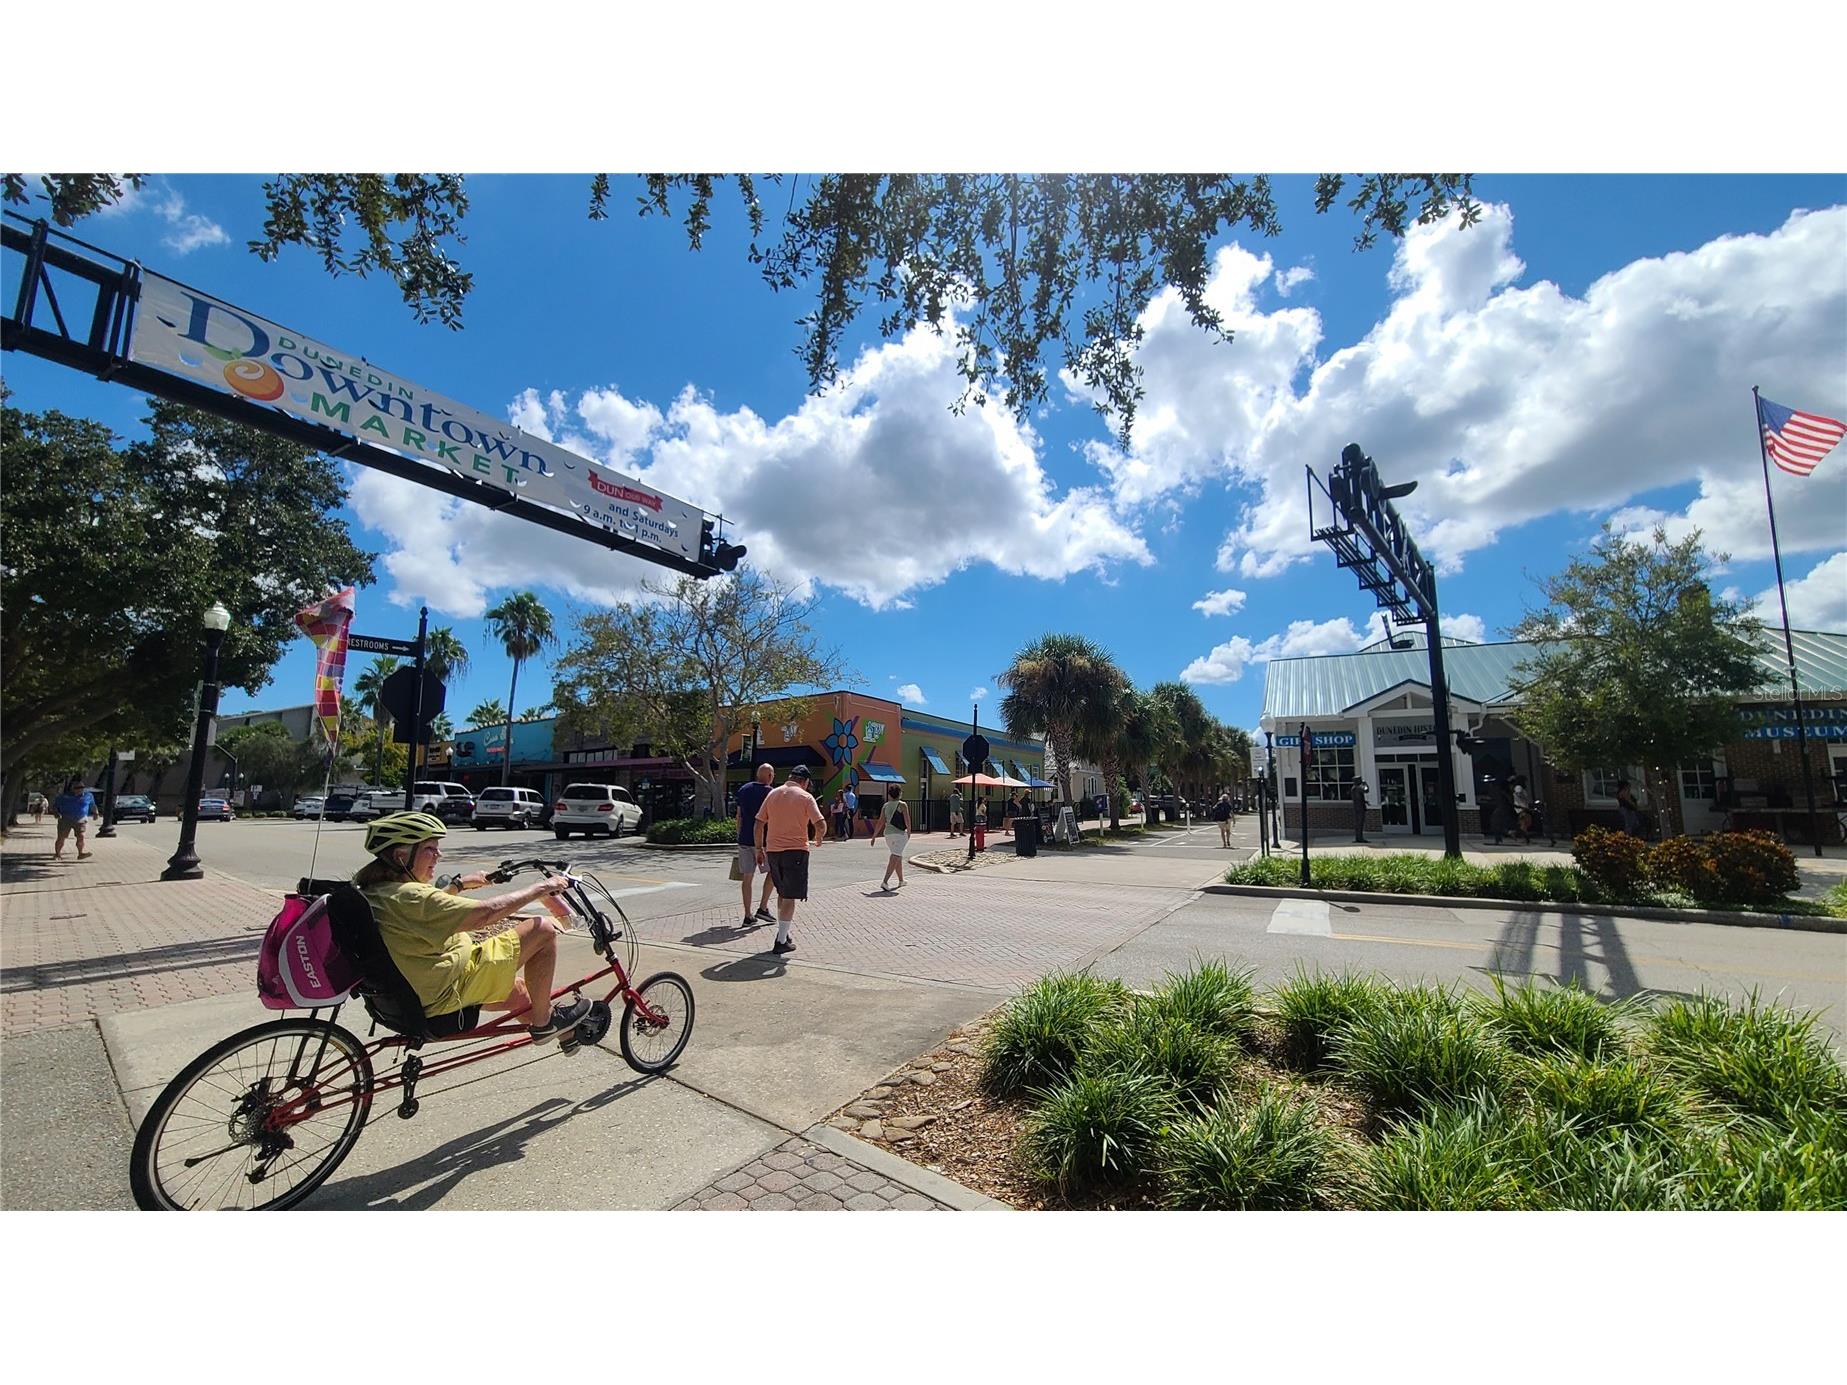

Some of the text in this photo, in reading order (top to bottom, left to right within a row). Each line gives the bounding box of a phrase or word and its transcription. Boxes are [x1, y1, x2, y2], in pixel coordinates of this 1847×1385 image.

[177, 291, 549, 475] Downtown
[278, 336, 414, 400] DUNEDIN
[310, 391, 519, 484] MARKET
[597, 481, 624, 498] DUN
[583, 504, 591, 514] 9
[593, 510, 616, 525] a.m.
[641, 528, 662, 543] p.m.
[608, 503, 679, 538] and Saturdays
[1279, 735, 1353, 746] GIF SHOP
[295, 935, 322, 989] EASTON
